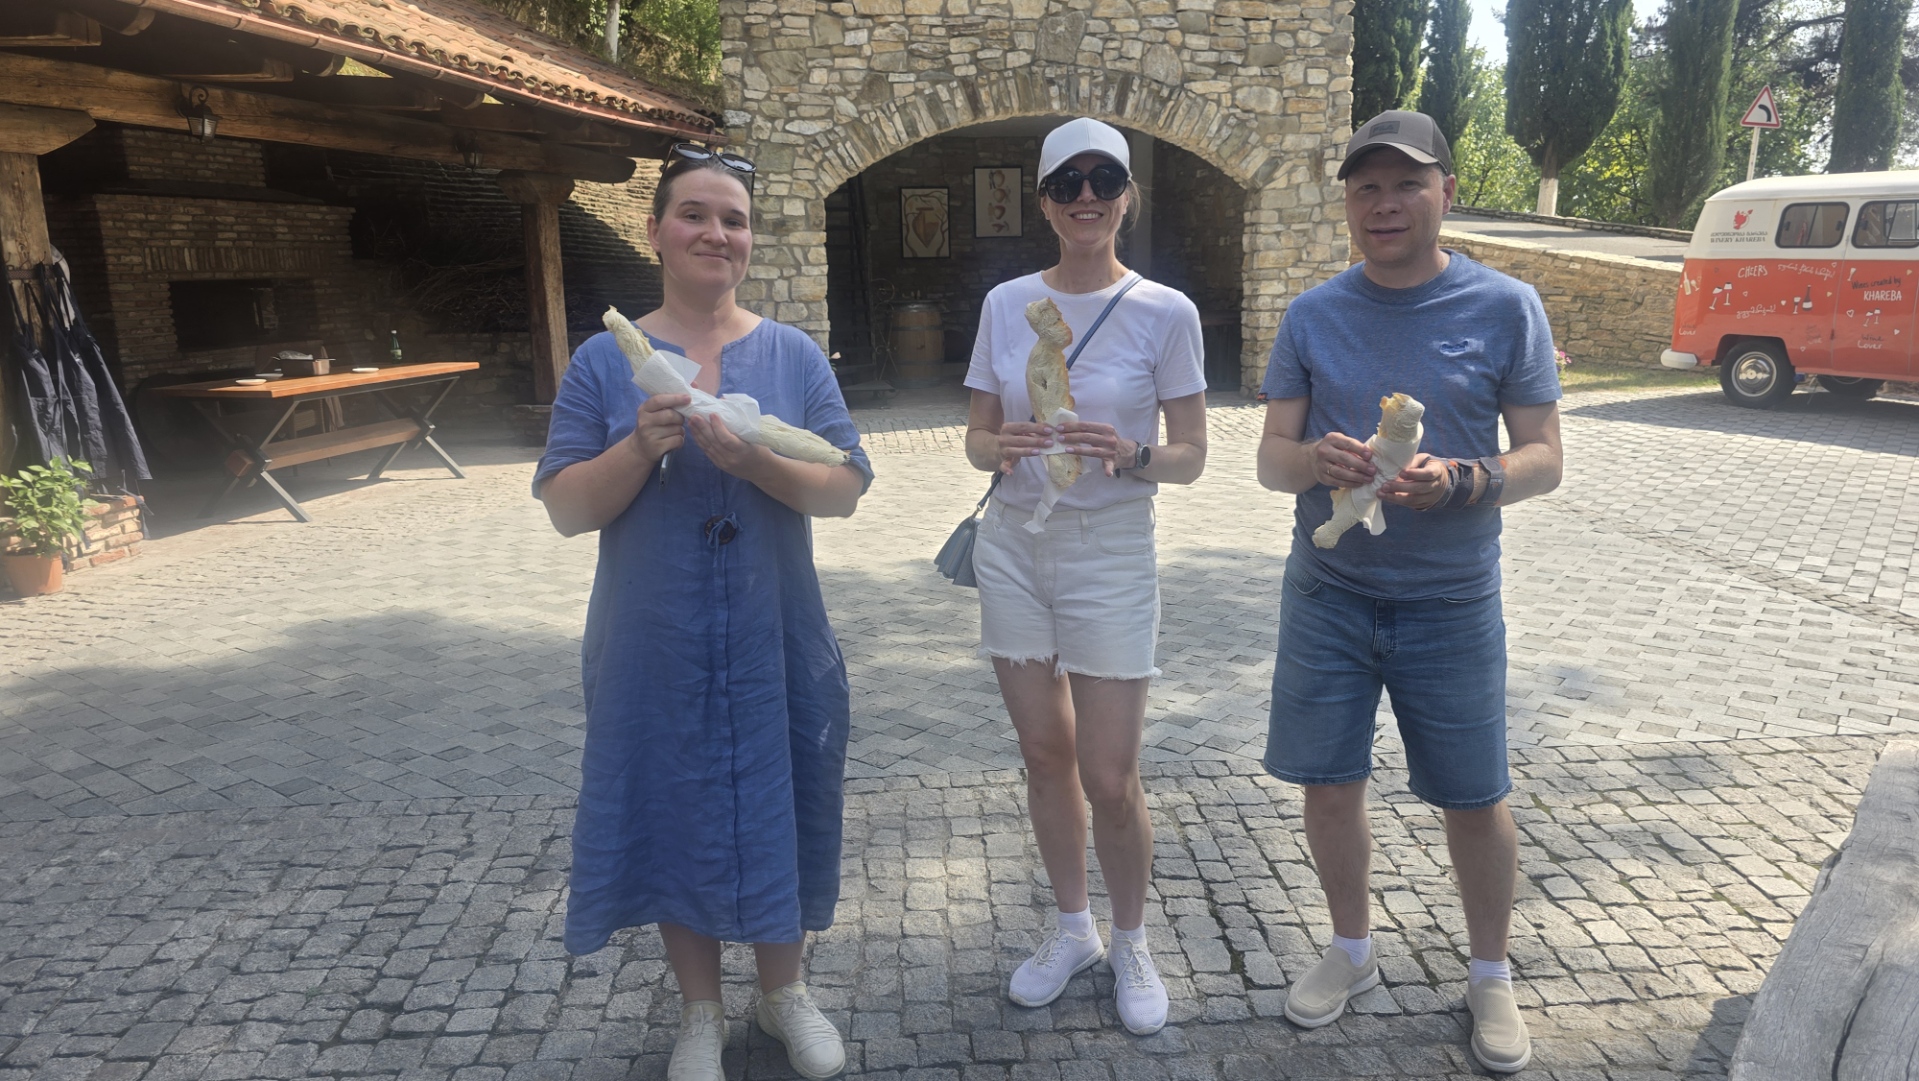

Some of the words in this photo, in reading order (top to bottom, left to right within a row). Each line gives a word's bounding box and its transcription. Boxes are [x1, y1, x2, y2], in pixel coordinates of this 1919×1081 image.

[1738, 264, 1768, 278] CHEERS
[1871, 276, 1892, 286] created
[1893, 276, 1902, 287] by
[1863, 290, 1902, 301] KHAREBA
[1857, 339, 1882, 349] Lover
